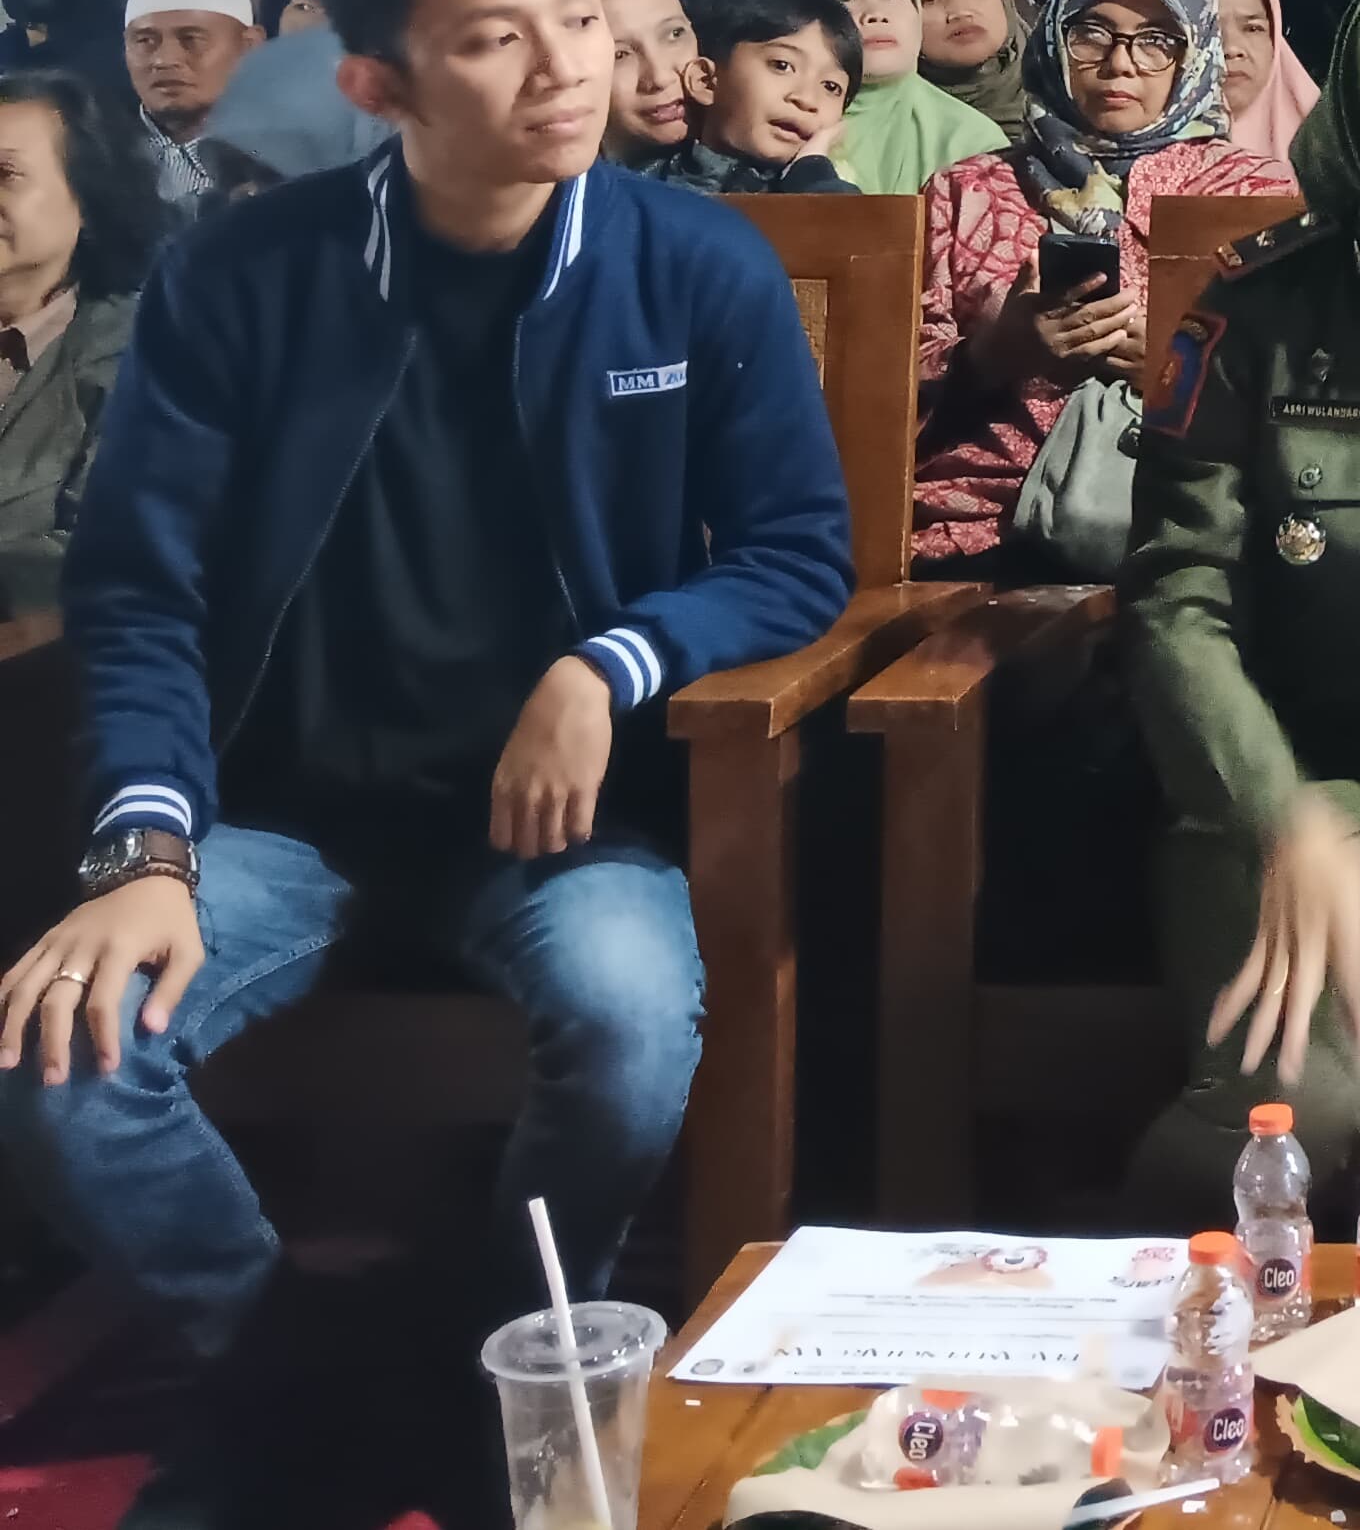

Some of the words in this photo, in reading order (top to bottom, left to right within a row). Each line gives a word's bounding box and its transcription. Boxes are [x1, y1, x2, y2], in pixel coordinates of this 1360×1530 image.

[618, 373, 656, 391] MM
[1264, 1266, 1295, 1288] Cleo
[908, 1419, 937, 1460] Cleo
[1213, 1417, 1245, 1442] Cleo
